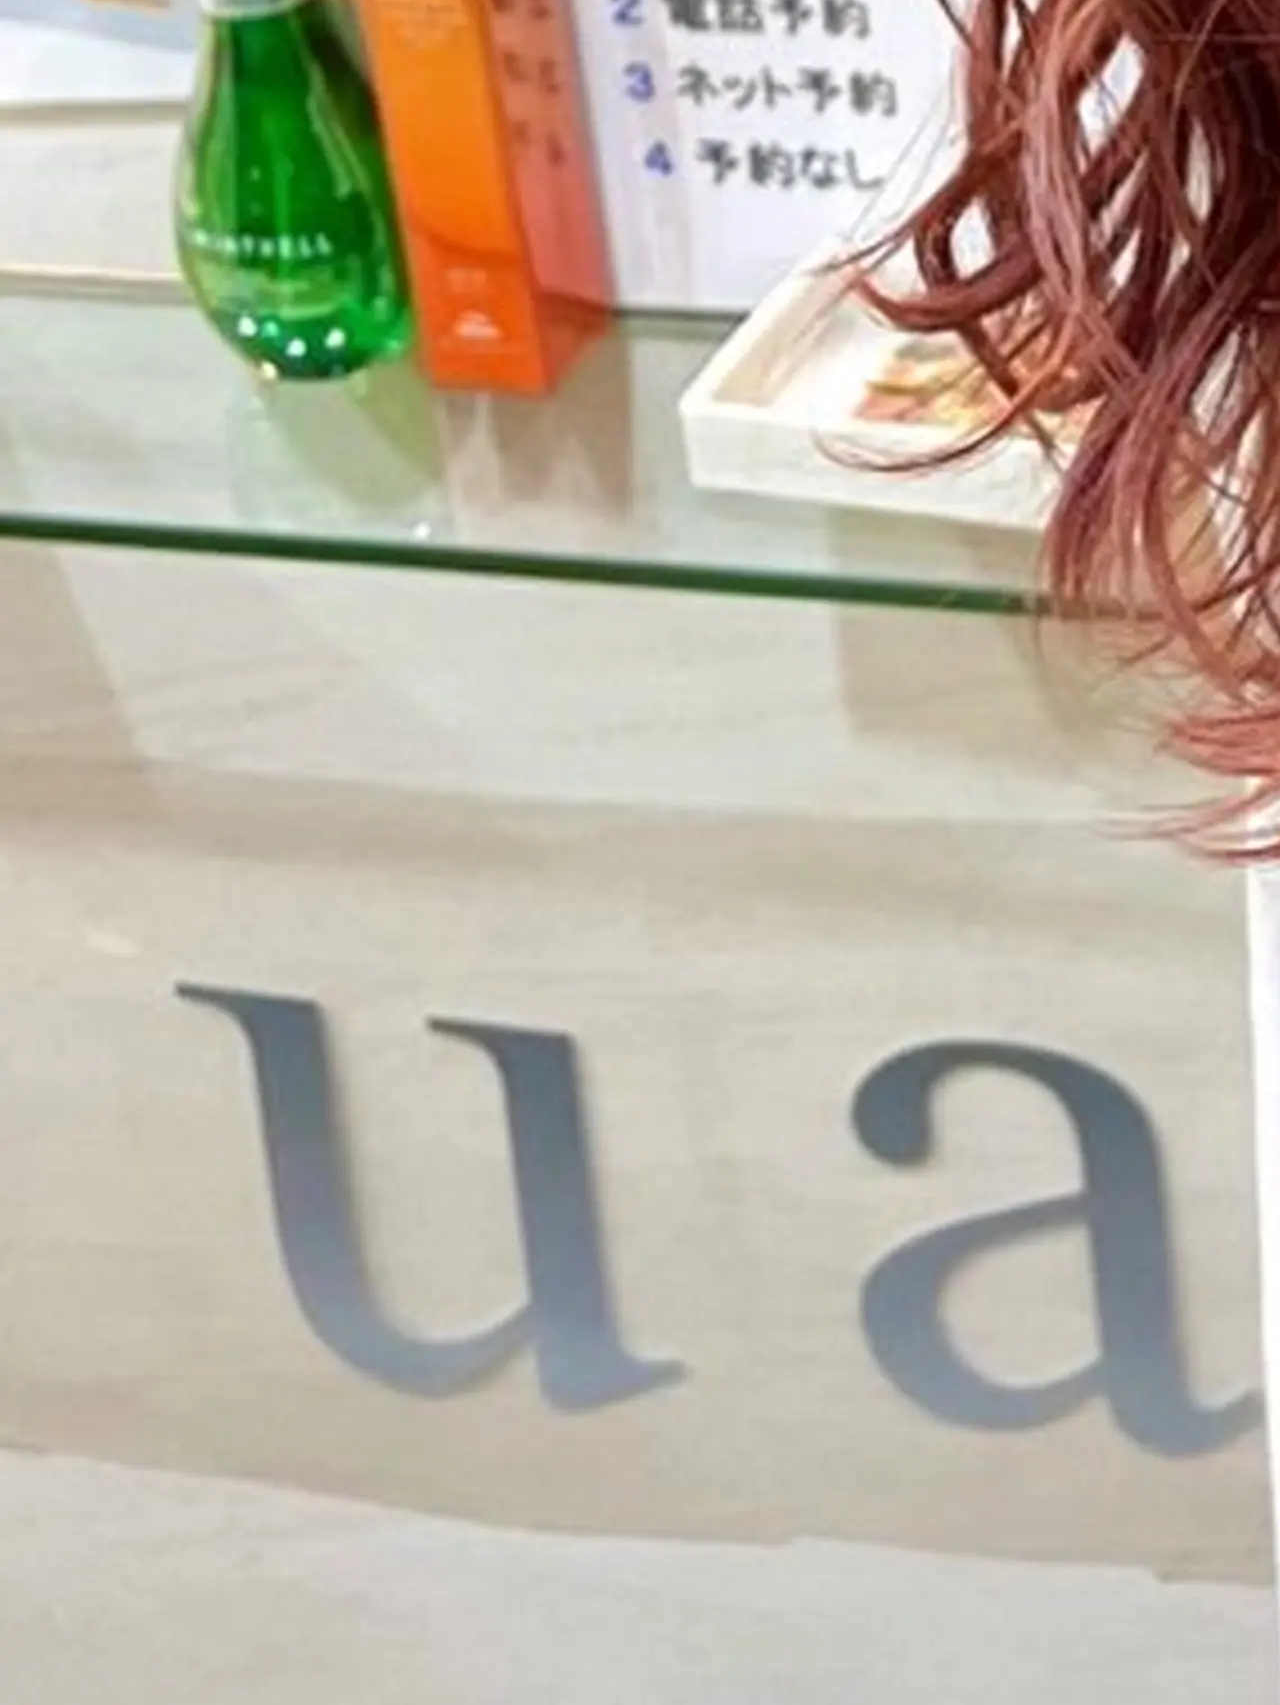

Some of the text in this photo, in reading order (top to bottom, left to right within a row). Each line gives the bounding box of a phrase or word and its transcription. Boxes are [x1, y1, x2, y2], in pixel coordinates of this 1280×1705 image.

[623, 60, 898, 118] 3 ネット予約
[644, 136, 886, 192] 4 予約なし
